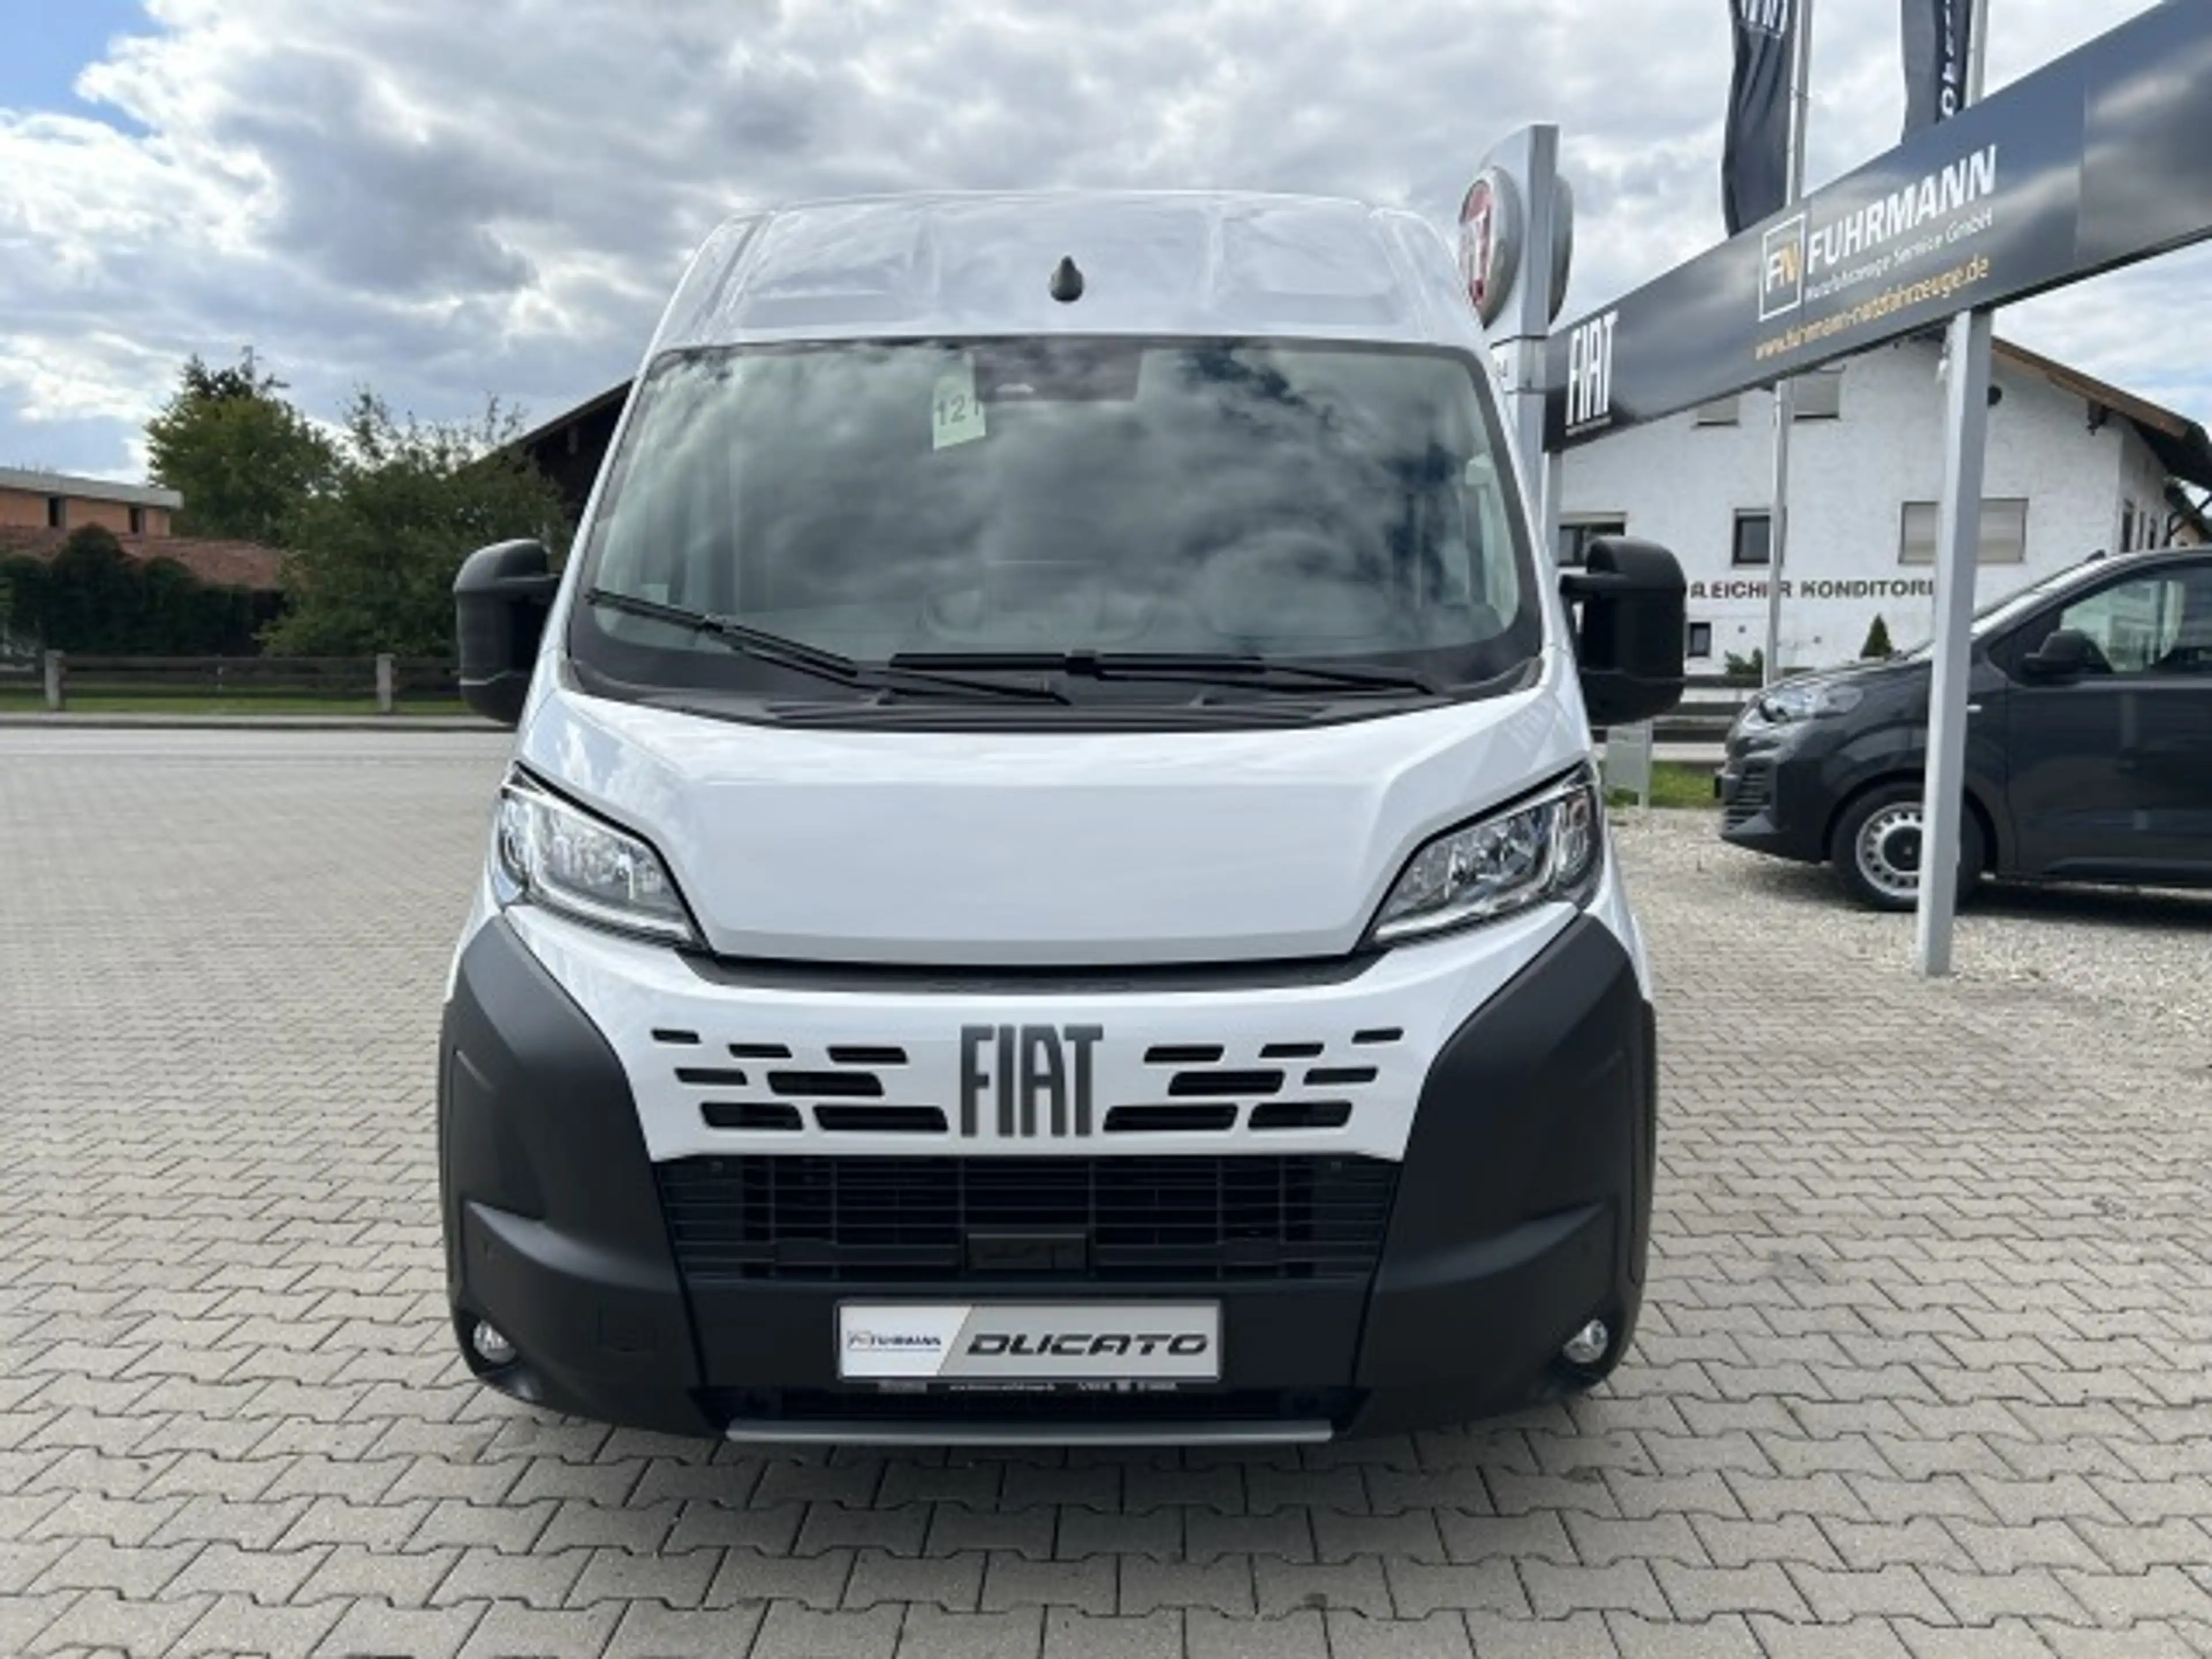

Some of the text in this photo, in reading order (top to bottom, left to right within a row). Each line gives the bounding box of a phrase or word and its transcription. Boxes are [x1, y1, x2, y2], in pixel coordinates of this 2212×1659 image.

[1808, 144, 1996, 274] FUHRMANN
[1945, 207, 1993, 243] GmbH
[1566, 310, 1619, 425] FIAT
[960, 1024, 1103, 1137] FIAT
[967, 1334, 1209, 1355] DUCATO
